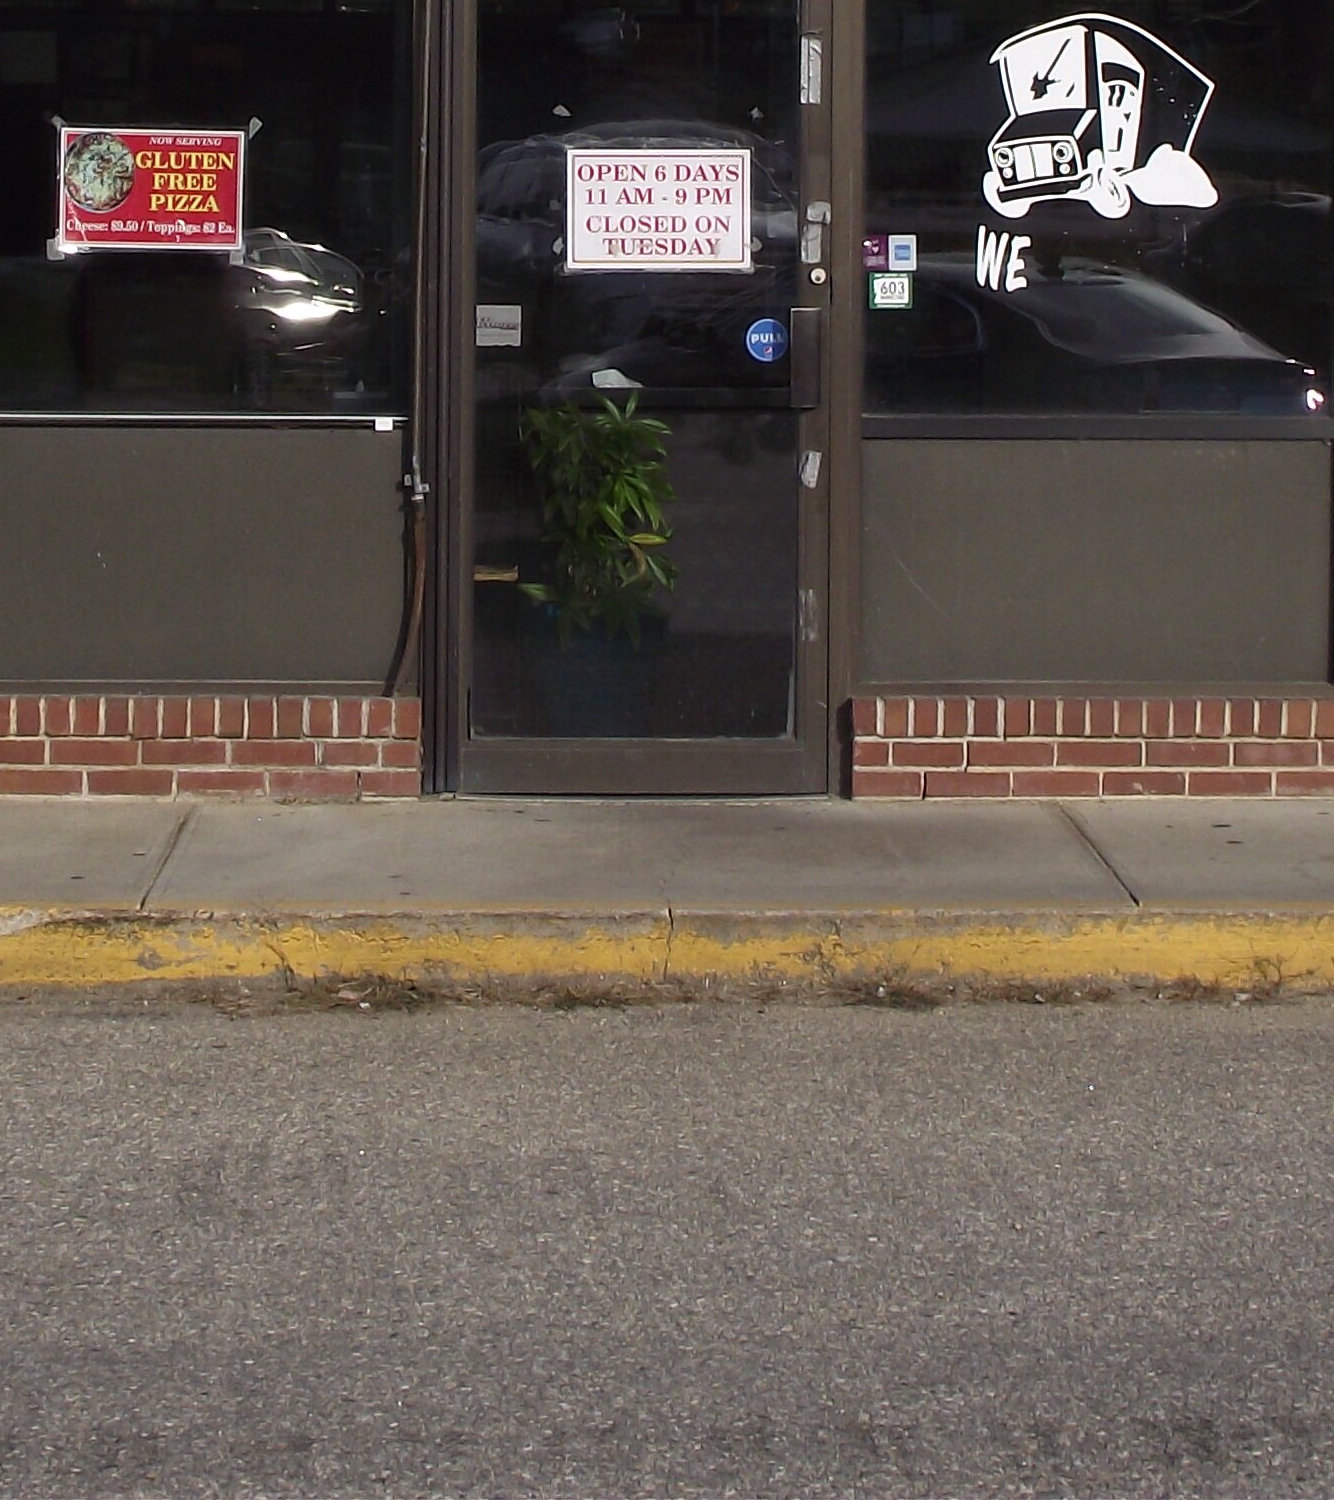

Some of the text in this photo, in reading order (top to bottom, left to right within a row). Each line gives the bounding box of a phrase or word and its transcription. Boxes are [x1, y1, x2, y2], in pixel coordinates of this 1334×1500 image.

[149, 136, 222, 146] NOW SERVING
[135, 150, 236, 170] GLUTEN
[152, 172, 218, 191] FREE
[577, 164, 740, 182] OPEN 6 DAYS
[149, 194, 220, 213] PIZZA
[585, 188, 607, 205] 11
[617, 188, 654, 205] AM
[675, 188, 688, 206] 9
[695, 188, 733, 205] PM
[585, 215, 731, 233] CLOSED ON
[602, 238, 723, 256] TUESDAY
[976, 224, 1032, 293] WE
[880, 281, 905, 295] 603
